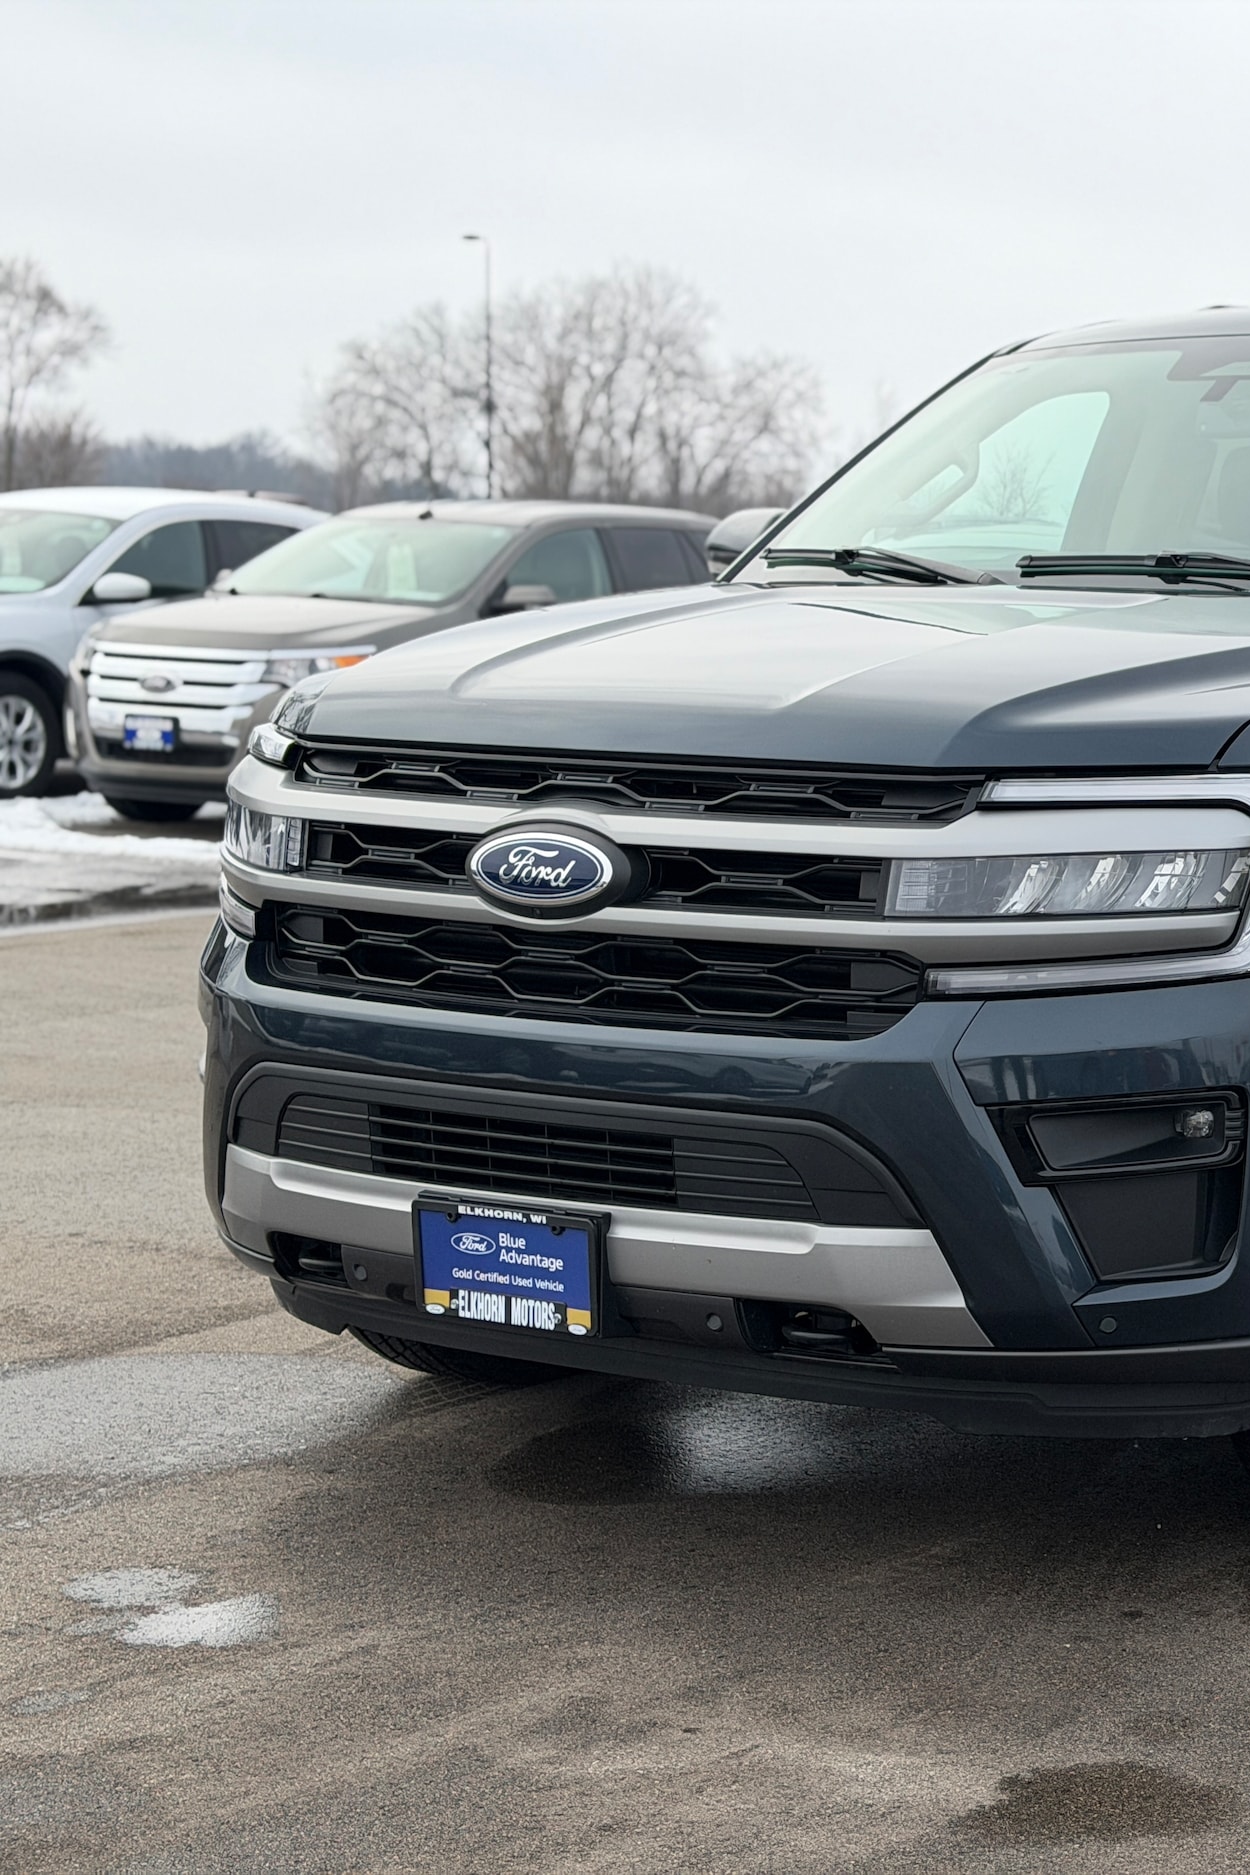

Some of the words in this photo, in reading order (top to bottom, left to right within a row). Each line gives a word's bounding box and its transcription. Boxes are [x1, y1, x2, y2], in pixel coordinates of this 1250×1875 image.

[499, 846, 576, 888] Ford
[457, 1205, 527, 1223] ELKHORN,
[530, 1214, 547, 1224] WI
[459, 1235, 487, 1252] Ford
[499, 1232, 526, 1249] Blue
[499, 1249, 564, 1271] Advantage
[452, 1267, 473, 1279] Gold
[474, 1270, 510, 1285] Certified
[511, 1274, 533, 1288] Used
[534, 1279, 565, 1292] Vehicle
[458, 1290, 506, 1323] ELKHORN
[511, 1297, 556, 1330] MOTORS
